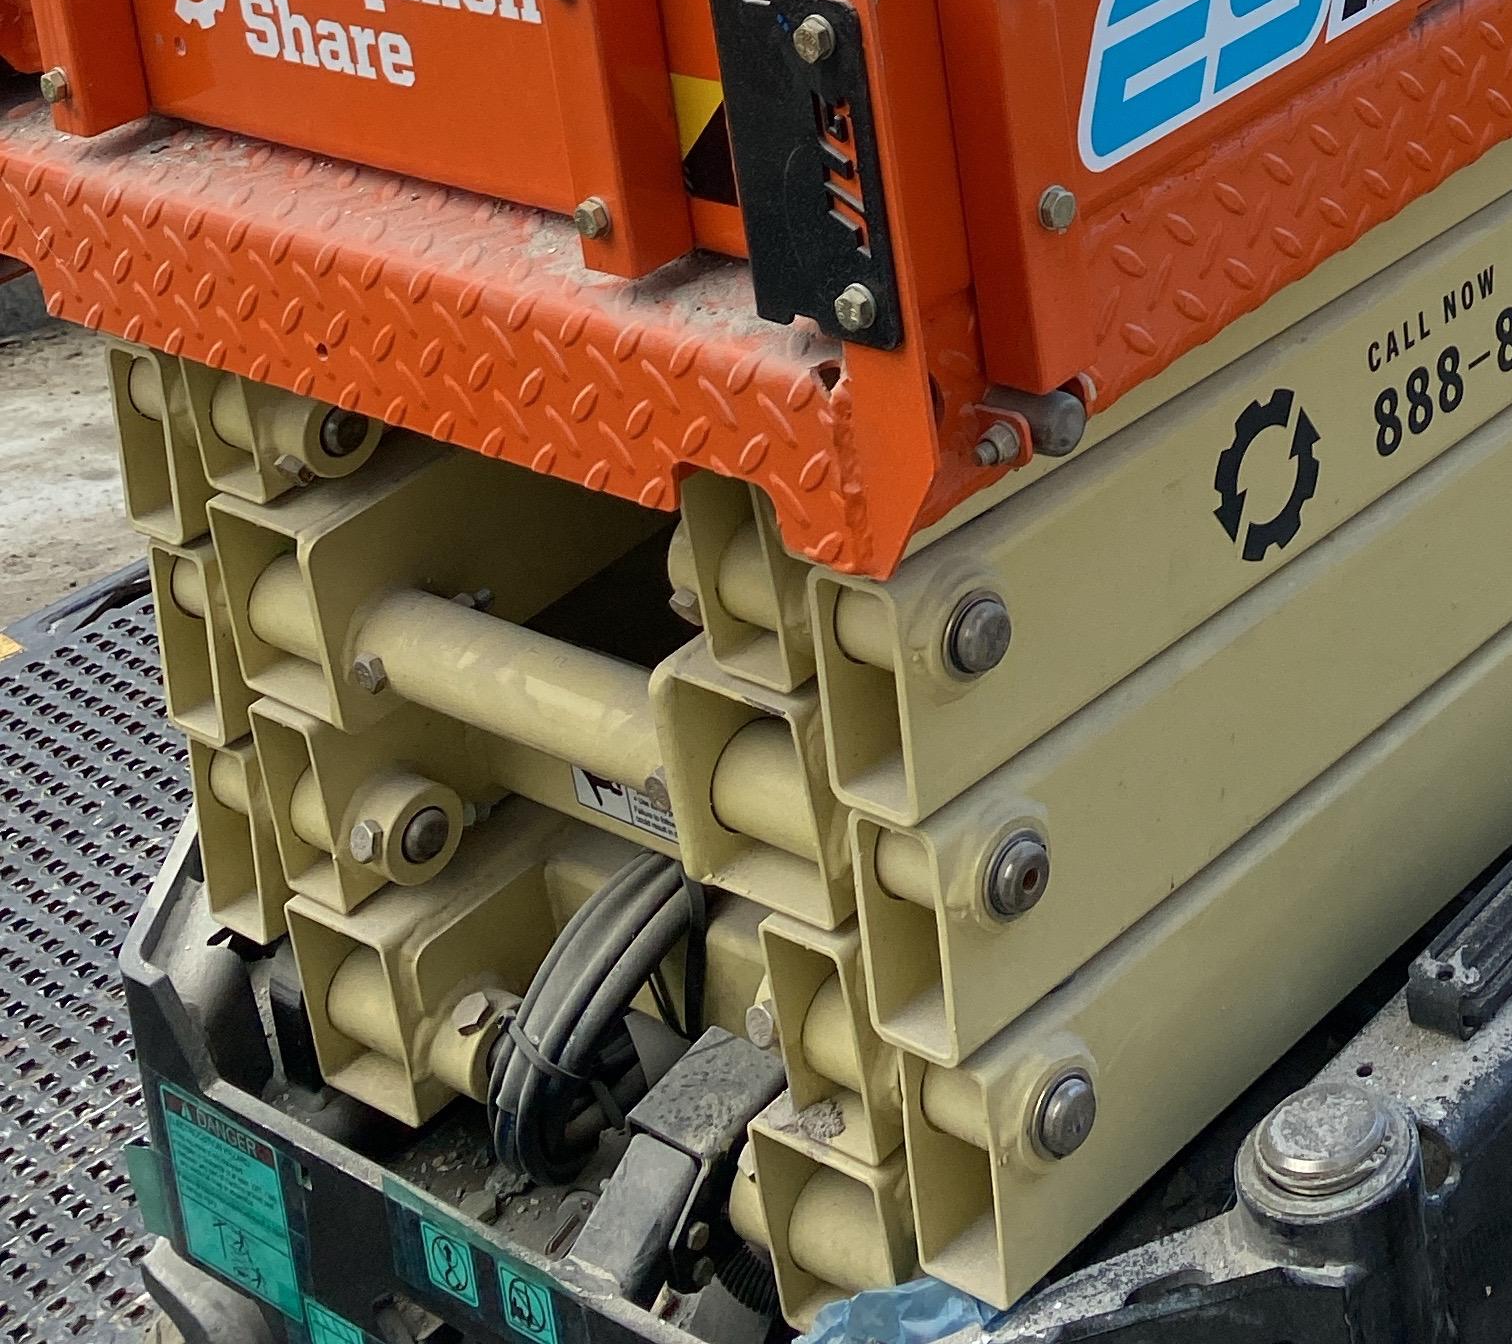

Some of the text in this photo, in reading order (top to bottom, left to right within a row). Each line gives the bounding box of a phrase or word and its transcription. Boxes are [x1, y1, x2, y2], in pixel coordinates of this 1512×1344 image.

[811, 91, 872, 260] JLG
[1367, 264, 1496, 373] CALL NOW
[196, 1107, 258, 1158] DANGER
